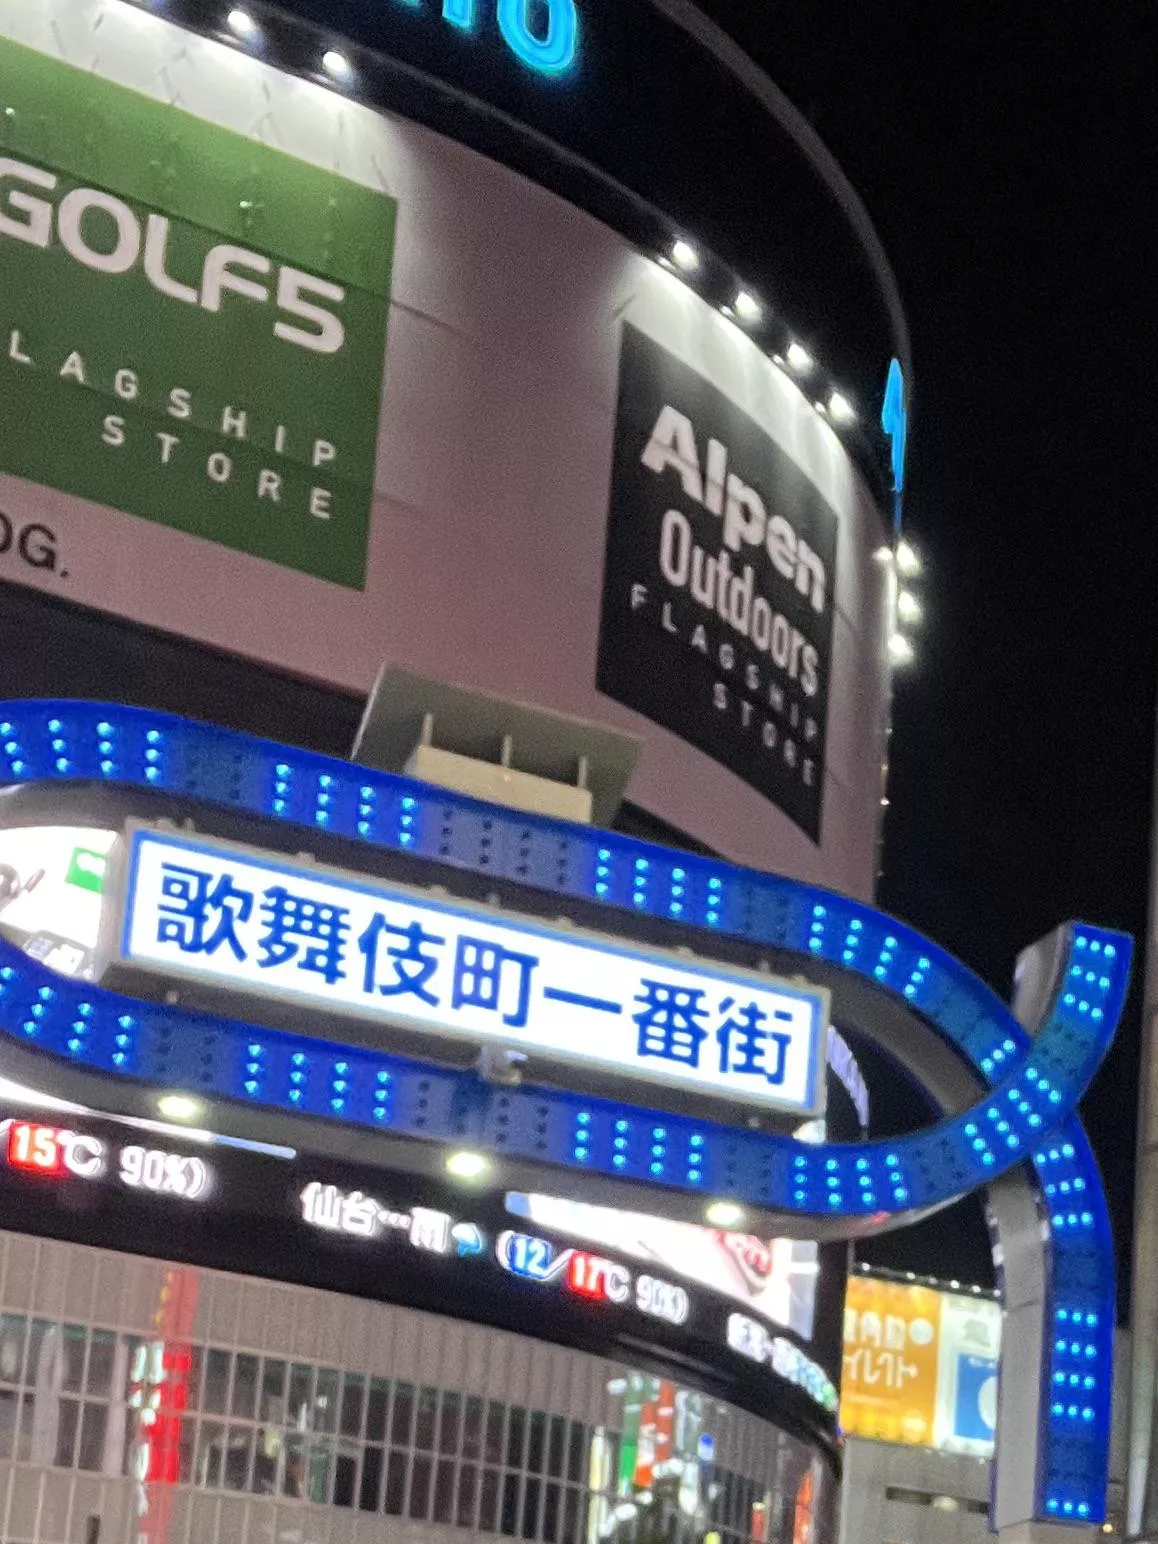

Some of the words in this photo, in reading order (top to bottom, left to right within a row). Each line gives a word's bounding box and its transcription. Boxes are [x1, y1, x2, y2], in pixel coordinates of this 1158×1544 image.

[0, 157, 346, 355] GOLF5
[102, 415, 332, 520] STORE
[640, 404, 826, 615] Alpen
[659, 509, 820, 698] Outdoors
[155, 862, 795, 1086] 歌舞伎町一番街
